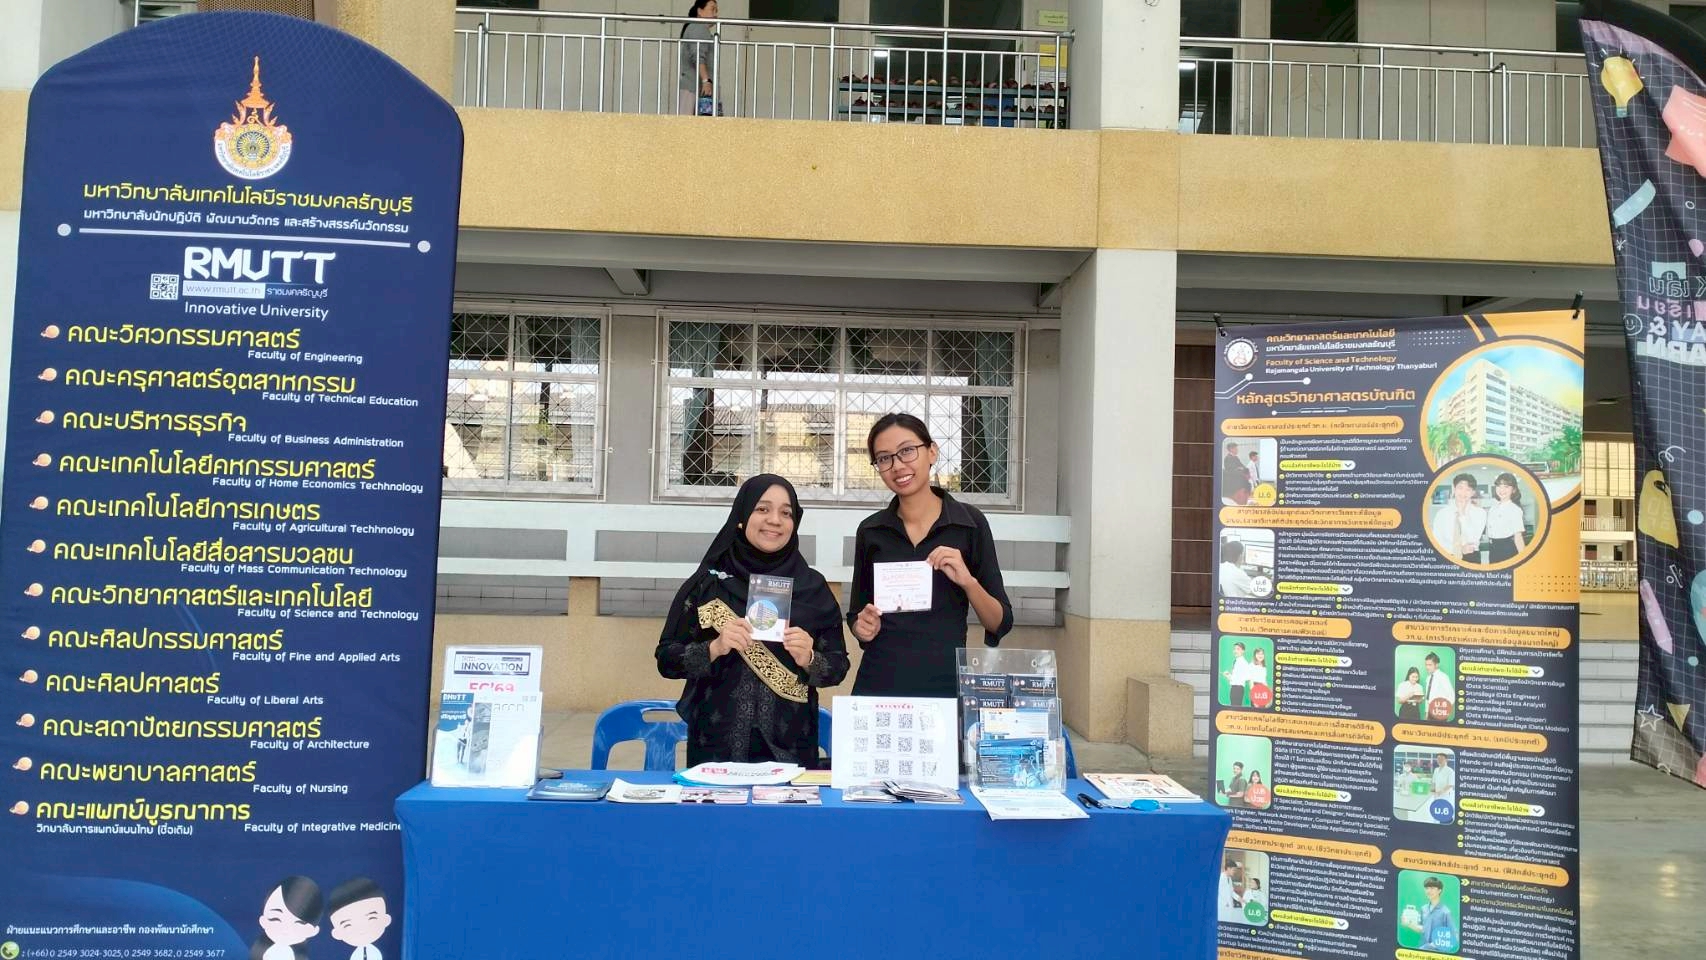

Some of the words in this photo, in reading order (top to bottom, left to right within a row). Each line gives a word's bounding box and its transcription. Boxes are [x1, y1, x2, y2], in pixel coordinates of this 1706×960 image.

[84, 182, 413, 216] มหาวิทยาลัยเทคโนโลยีราชมงคลธัญบุรี
[84, 208, 202, 225] มหาวิทยาลัยนักปฏิบัติ
[206, 212, 280, 226] พัฒนานวัตกร
[284, 216, 409, 234] และสร้างสรรค์นวัตกรรม
[184, 246, 337, 285] RMUTT
[186, 284, 262, 295] www.rmutt.ac.th
[185, 301, 257, 316] Innovative
[260, 304, 329, 321] University
[68, 325, 300, 349] คณะวิศวกรรมศาสตร์
[1266, 328, 1396, 343] คณะวิทยาศาสตร์และเทคโนโลยี
[1266, 340, 1396, 352] มหาวิทยาลัยเทคโนโลยีราชมงคลธัญบุรี
[248, 350, 287, 362] Faculty
[290, 352, 302, 362] of
[304, 353, 363, 365] Engineering
[1266, 359, 1293, 367] Faculty
[1295, 358, 1304, 366] of
[1304, 357, 1334, 366] Science
[1335, 356, 1350, 364] and
[1351, 354, 1397, 364] Technology
[1266, 367, 1309, 375] Rajamangala
[1310, 366, 1344, 374] University
[1355, 364, 1395, 372] Technology
[1396, 362, 1438, 370] Thanyaburi
[65, 368, 356, 394] คณะครุศาสตร์อุตสาหกรรม
[262, 392, 301, 403] Faculty
[304, 394, 315, 403] of
[318, 394, 366, 404] Technical
[369, 396, 418, 407] Education
[1236, 388, 1416, 407] หลักสูตรวิทยาศาสตรบัณฑิต
[63, 411, 247, 437] คณะบริหารธุรกิจ
[228, 433, 267, 445] Faculty
[271, 434, 282, 445] of
[285, 435, 330, 445] Business
[334, 437, 404, 448] Administration
[59, 449, 376, 480] คณะเทคโนโลยีคหกรรมศาสตร์
[212, 477, 251, 489] Faculty
[255, 478, 266, 489] of
[269, 479, 299, 488] Home
[302, 480, 356, 490] Economics
[360, 481, 424, 494] Techhnology
[57, 493, 321, 521] คณะเทคโนโลยีการเกษตร
[232, 522, 272, 534] Faculty
[276, 522, 287, 533] of
[290, 523, 347, 534] Agricultural
[350, 525, 415, 537] Techhnology
[54, 536, 353, 565] คณะเทคโนโลยีสื่อสารมวลชน
[181, 563, 220, 575] Faculty
[224, 564, 235, 575] of
[238, 565, 264, 574] Mass
[268, 566, 346, 576] Communication
[350, 568, 408, 579] Technology
[51, 583, 372, 609] คณะวิทยาศาสตร์และเทคโนโลยี
[238, 608, 277, 620] Faculty
[280, 609, 292, 620] of
[294, 609, 334, 618] Science
[338, 609, 357, 619] and
[361, 610, 419, 622] Technology
[48, 628, 284, 651] คณะศิลปกรรมศาสตร์
[232, 652, 272, 664] Faculty
[276, 652, 287, 664] of
[290, 652, 312, 662] Fine
[316, 652, 335, 662] and
[339, 653, 376, 664] Applied
[380, 654, 401, 663] Arts
[462, 662, 523, 672] INNOVATION
[46, 672, 220, 695] คณะศิลปศาสตร์
[207, 696, 246, 707] Faculty
[250, 696, 262, 707] of
[264, 696, 299, 705] Liberal
[303, 697, 324, 706] Arts
[43, 716, 322, 738] คณะสถาปัตยกรรมศาสตร์
[250, 740, 289, 751] Faculty
[293, 740, 304, 751] of
[308, 740, 370, 750] Architecture
[40, 760, 256, 783] คณะพยาบาลศาสตร์
[253, 784, 292, 795] Faculty
[296, 784, 307, 795] of
[310, 784, 349, 795] Nursing
[36, 798, 251, 826] คณะแพทย์บูรณาการ
[1434, 808, 1449, 816] ม.6
[158, 824, 194, 836] (ชื่อเดิม)
[244, 823, 284, 834] Faculty
[288, 823, 299, 834] of
[302, 823, 357, 834] Integrative
[7, 924, 136, 935] ฝ่ายแนะแนวการศึกษาและอาชีพ
[139, 924, 214, 935] กองพัฒนานักศึกษา
[57, 949, 78, 958] 2549
[131, 949, 152, 958] 2549
[184, 949, 204, 958] 2549
[206, 949, 225, 958] 3677
